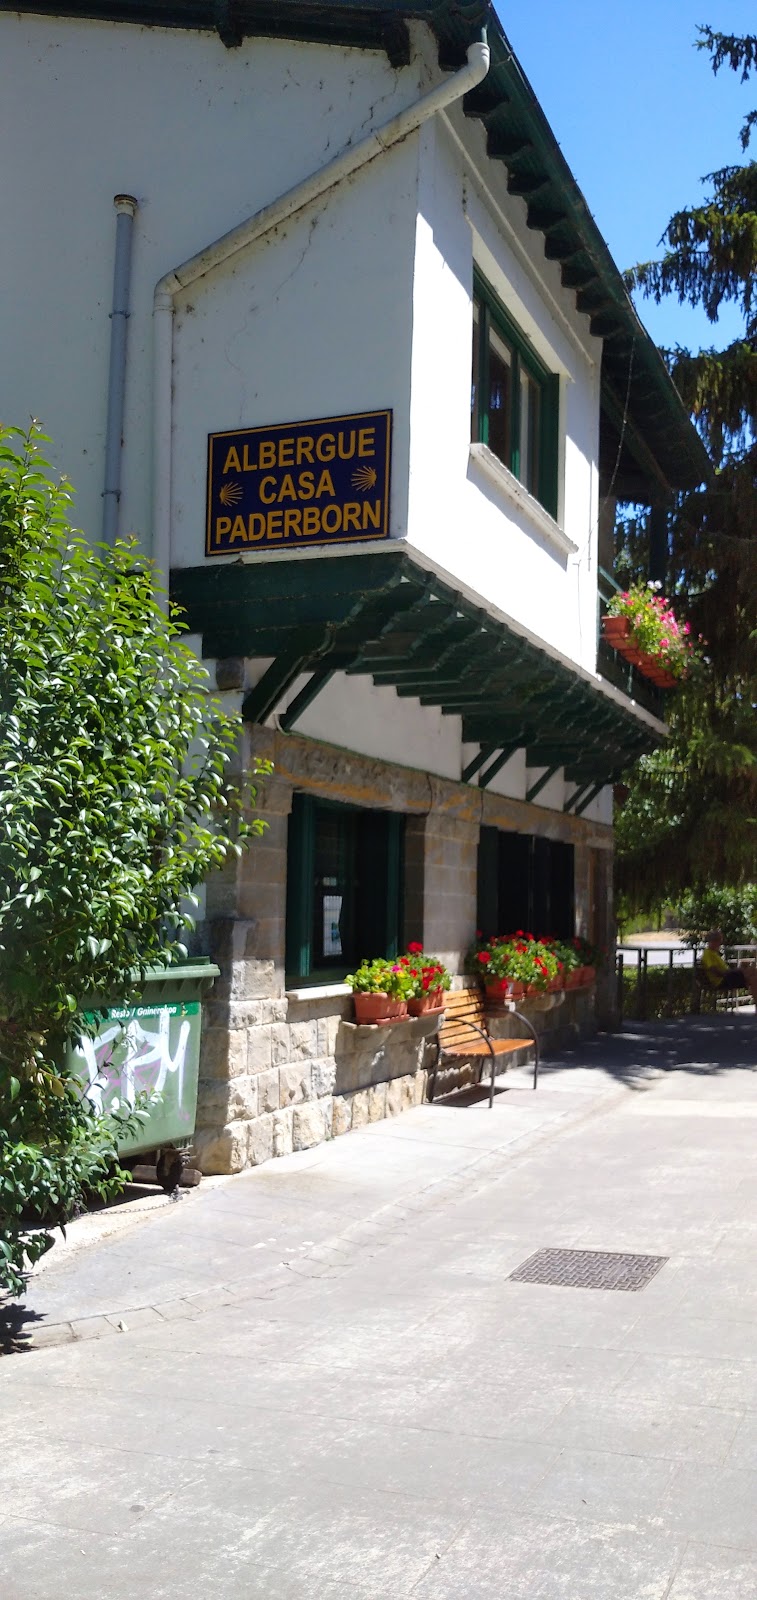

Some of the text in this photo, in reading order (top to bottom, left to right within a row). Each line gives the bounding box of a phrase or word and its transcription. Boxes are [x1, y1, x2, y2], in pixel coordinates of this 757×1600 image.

[222, 427, 376, 475] ALBERGUE
[258, 469, 336, 505] CASA
[215, 500, 381, 545] PADERBORN
